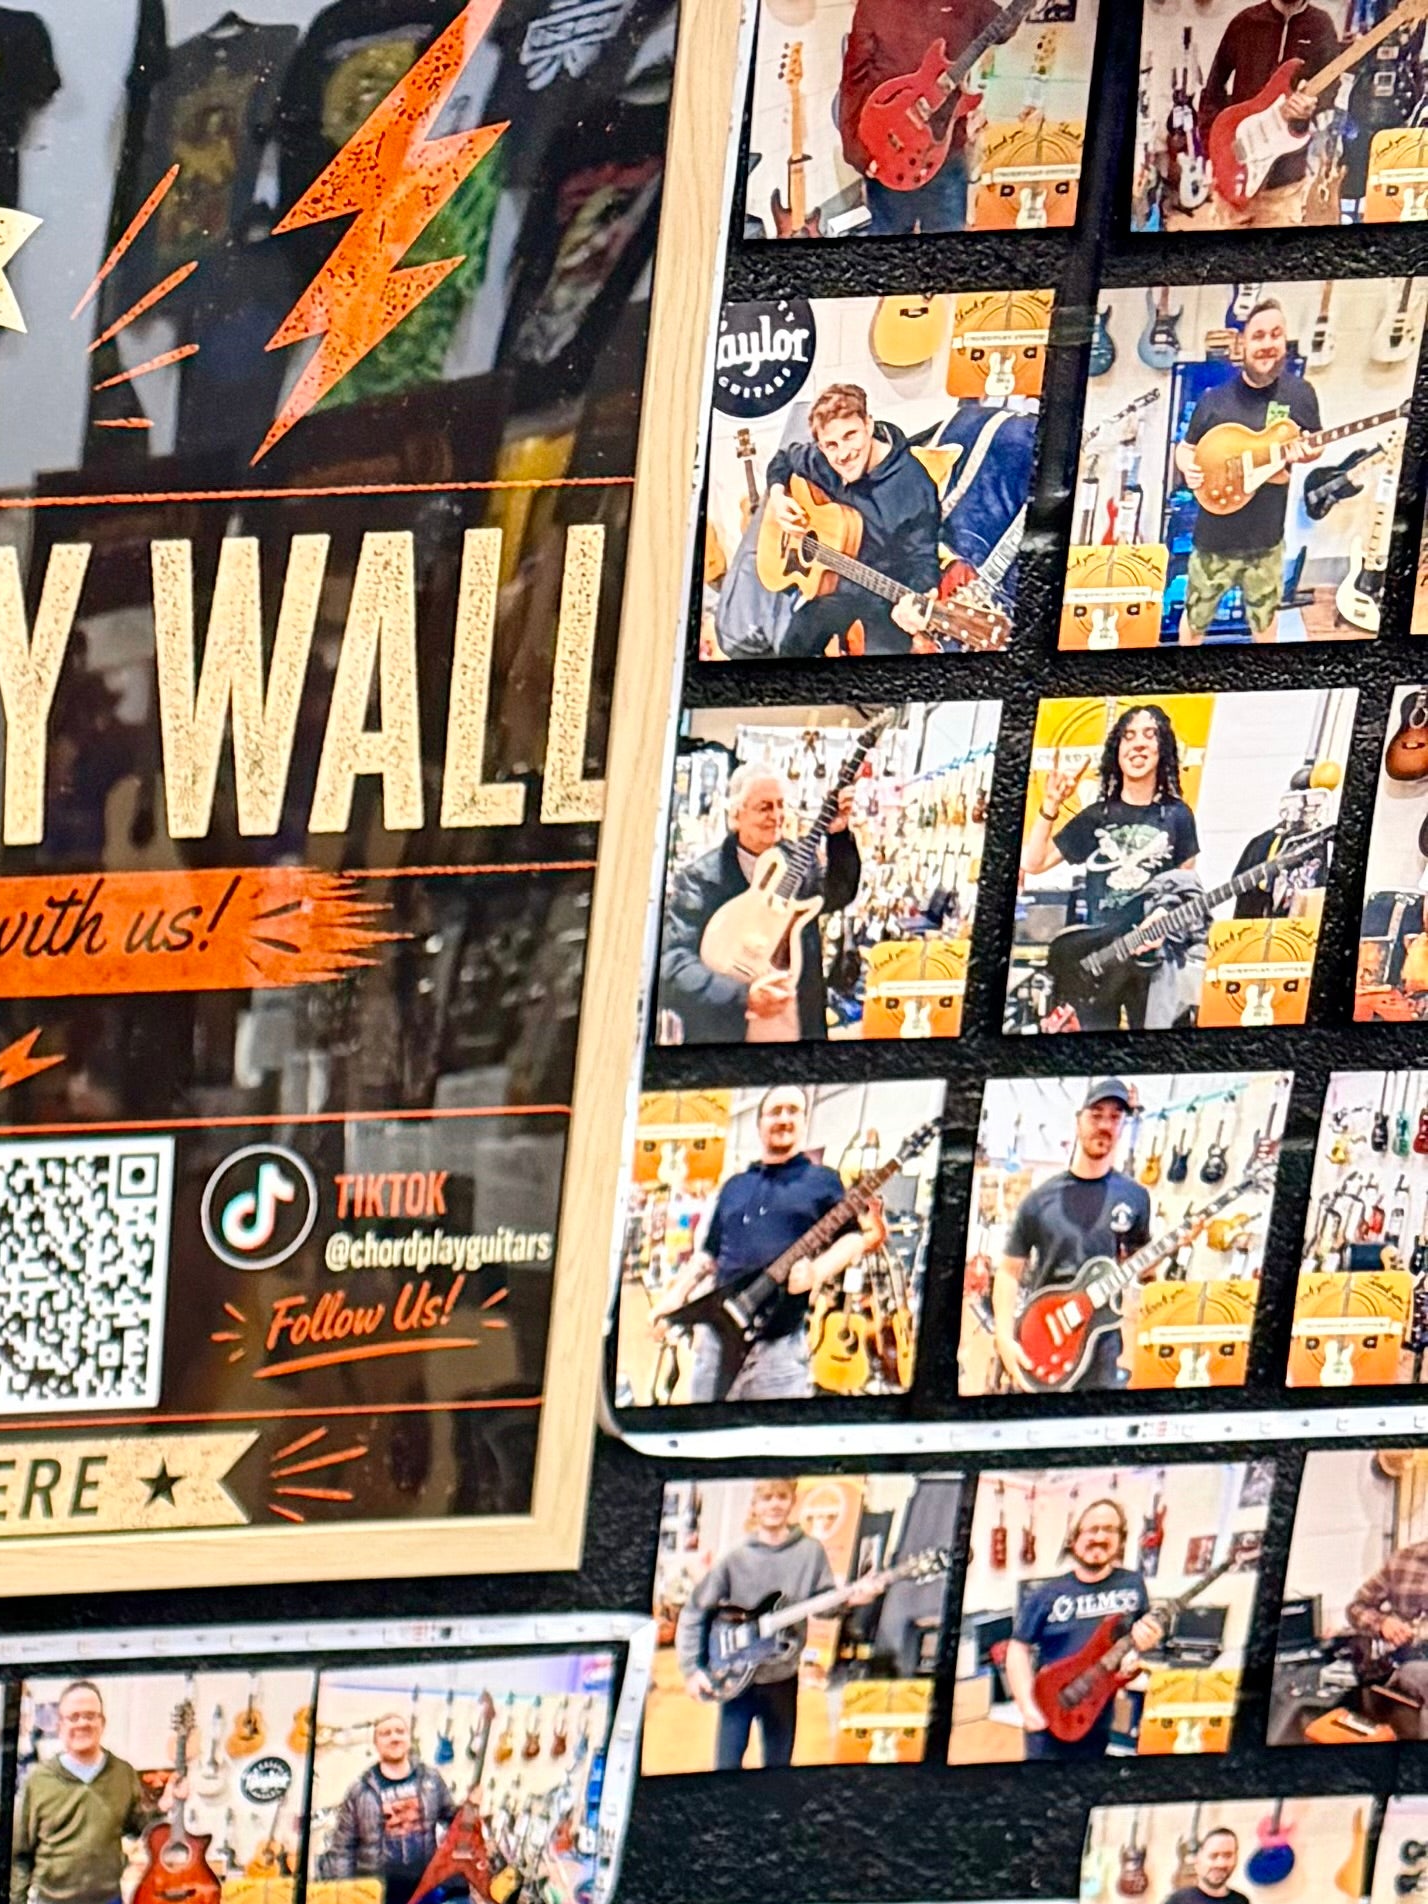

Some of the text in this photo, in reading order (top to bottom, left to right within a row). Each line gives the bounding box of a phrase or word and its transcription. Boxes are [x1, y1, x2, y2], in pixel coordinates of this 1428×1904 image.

[717, 315, 809, 377] aylor
[149, 524, 605, 839] WALL
[127, 875, 244, 953] us!
[335, 1170, 450, 1219] TIKTOK
[325, 1225, 554, 1273] @chordplayguitars
[266, 1274, 467, 1351] Follow Us!
